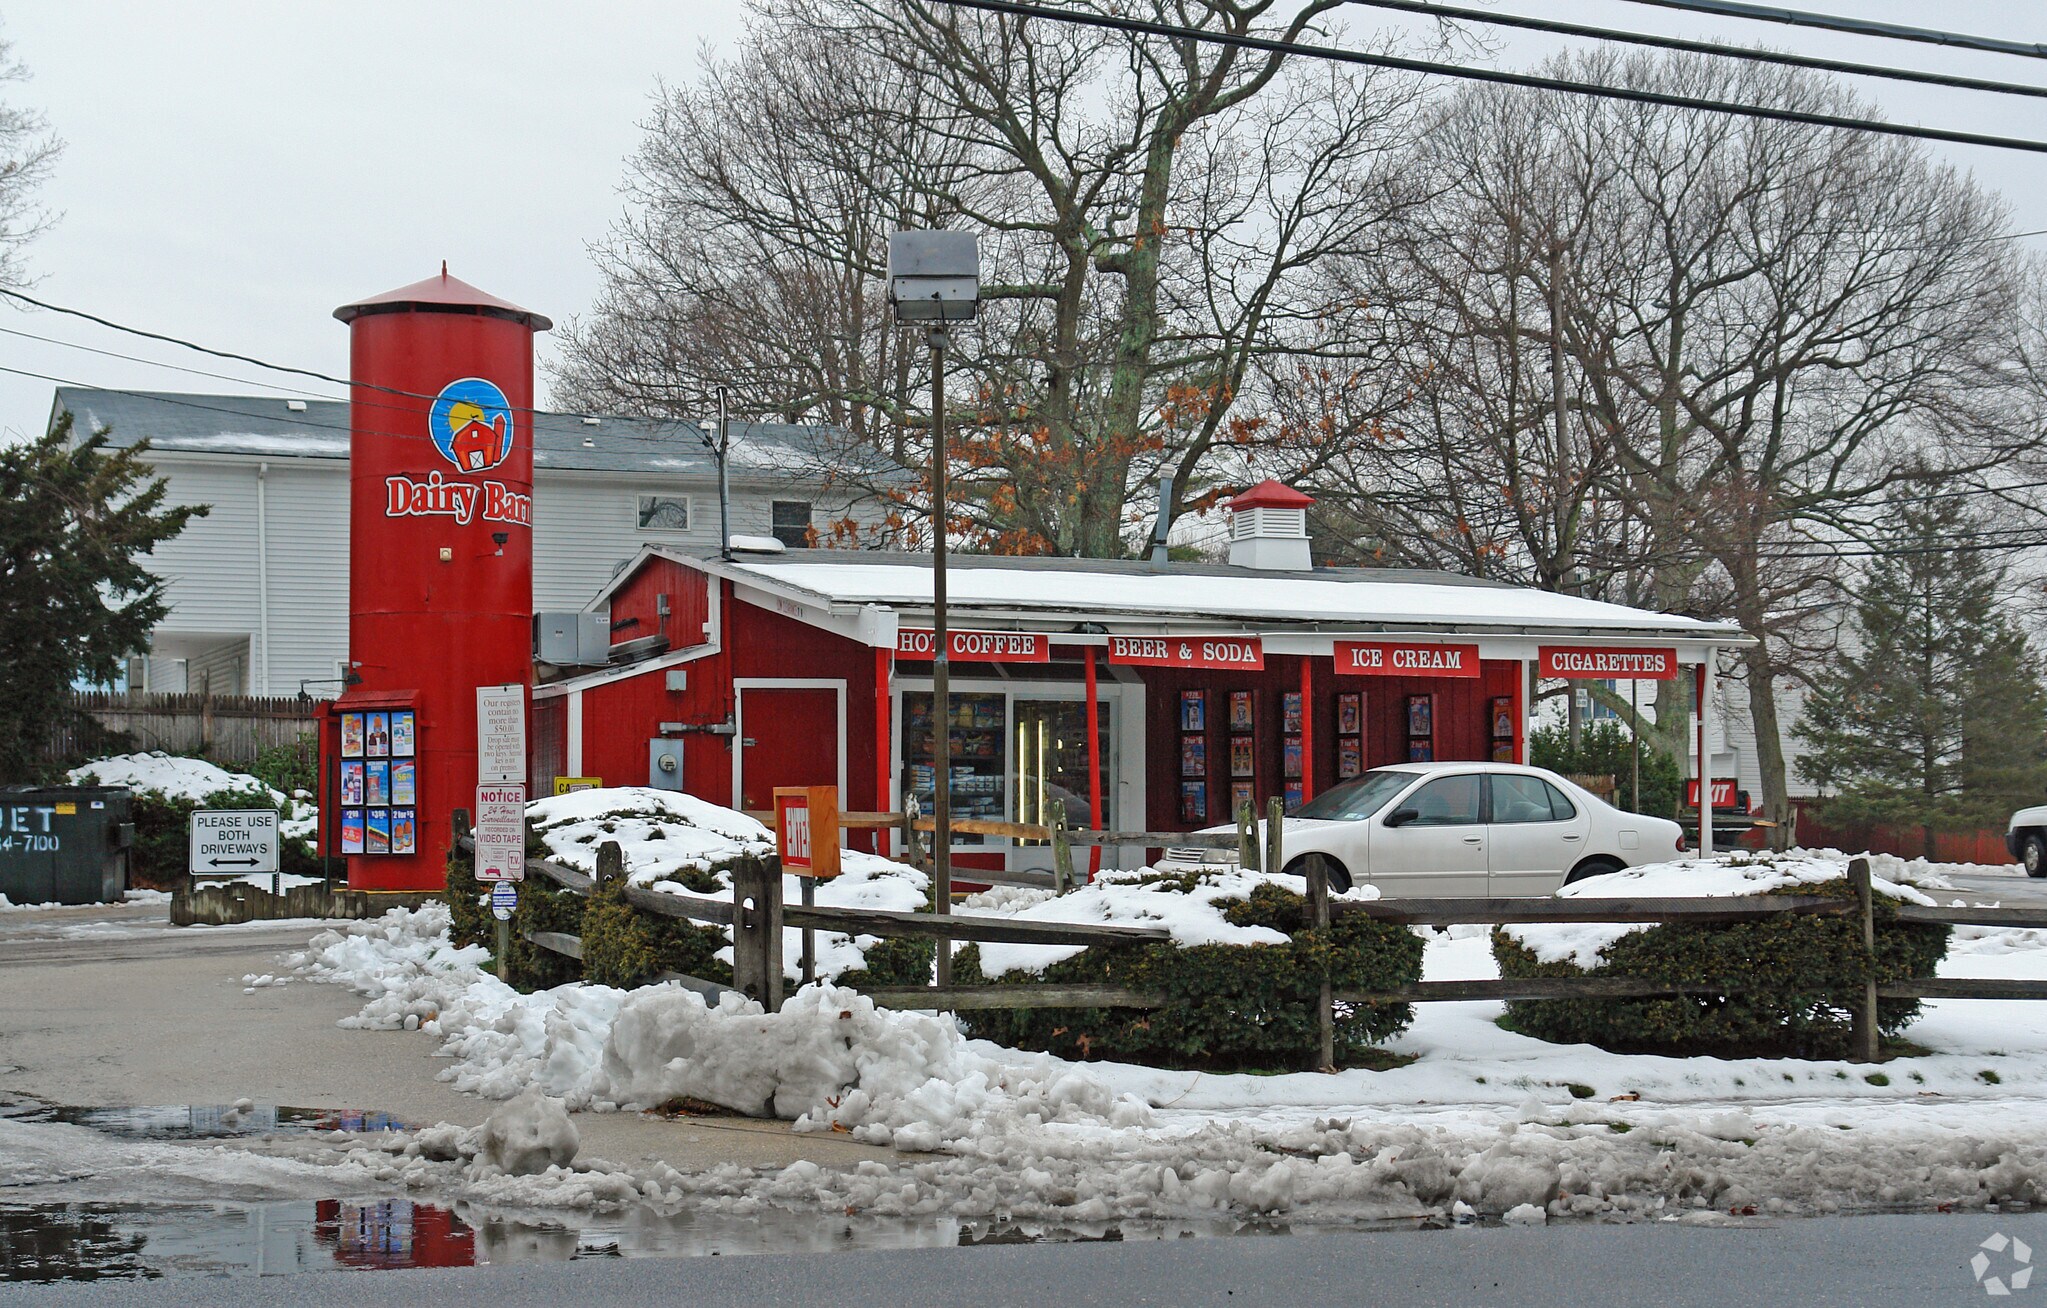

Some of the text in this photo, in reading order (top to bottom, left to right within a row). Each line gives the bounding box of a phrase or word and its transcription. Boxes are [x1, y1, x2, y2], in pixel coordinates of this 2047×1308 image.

[386, 470, 532, 527] Dairy Barn
[953, 633, 1035, 655] COFFEE
[1114, 637, 1257, 663] BEER & SODA
[1351, 648, 1462, 669] ICE CREAM
[1551, 652, 1666, 673] CIGARETTES
[483, 699, 499, 708] Our
[488, 717, 507, 725] more
[481, 791, 521, 803] NOTICE
[393, 811, 398, 819] 2
[487, 805, 516, 815] 24 Hour
[0, 806, 56, 832] ET
[197, 816, 272, 828] PLEASE USE
[481, 814, 520, 824] Surveillance
[218, 830, 250, 840] BOTH
[479, 834, 521, 843] VIDEO TAPE
[0, 835, 60, 853] 4-7100
[200, 843, 268, 854] DRIVEWAYS
